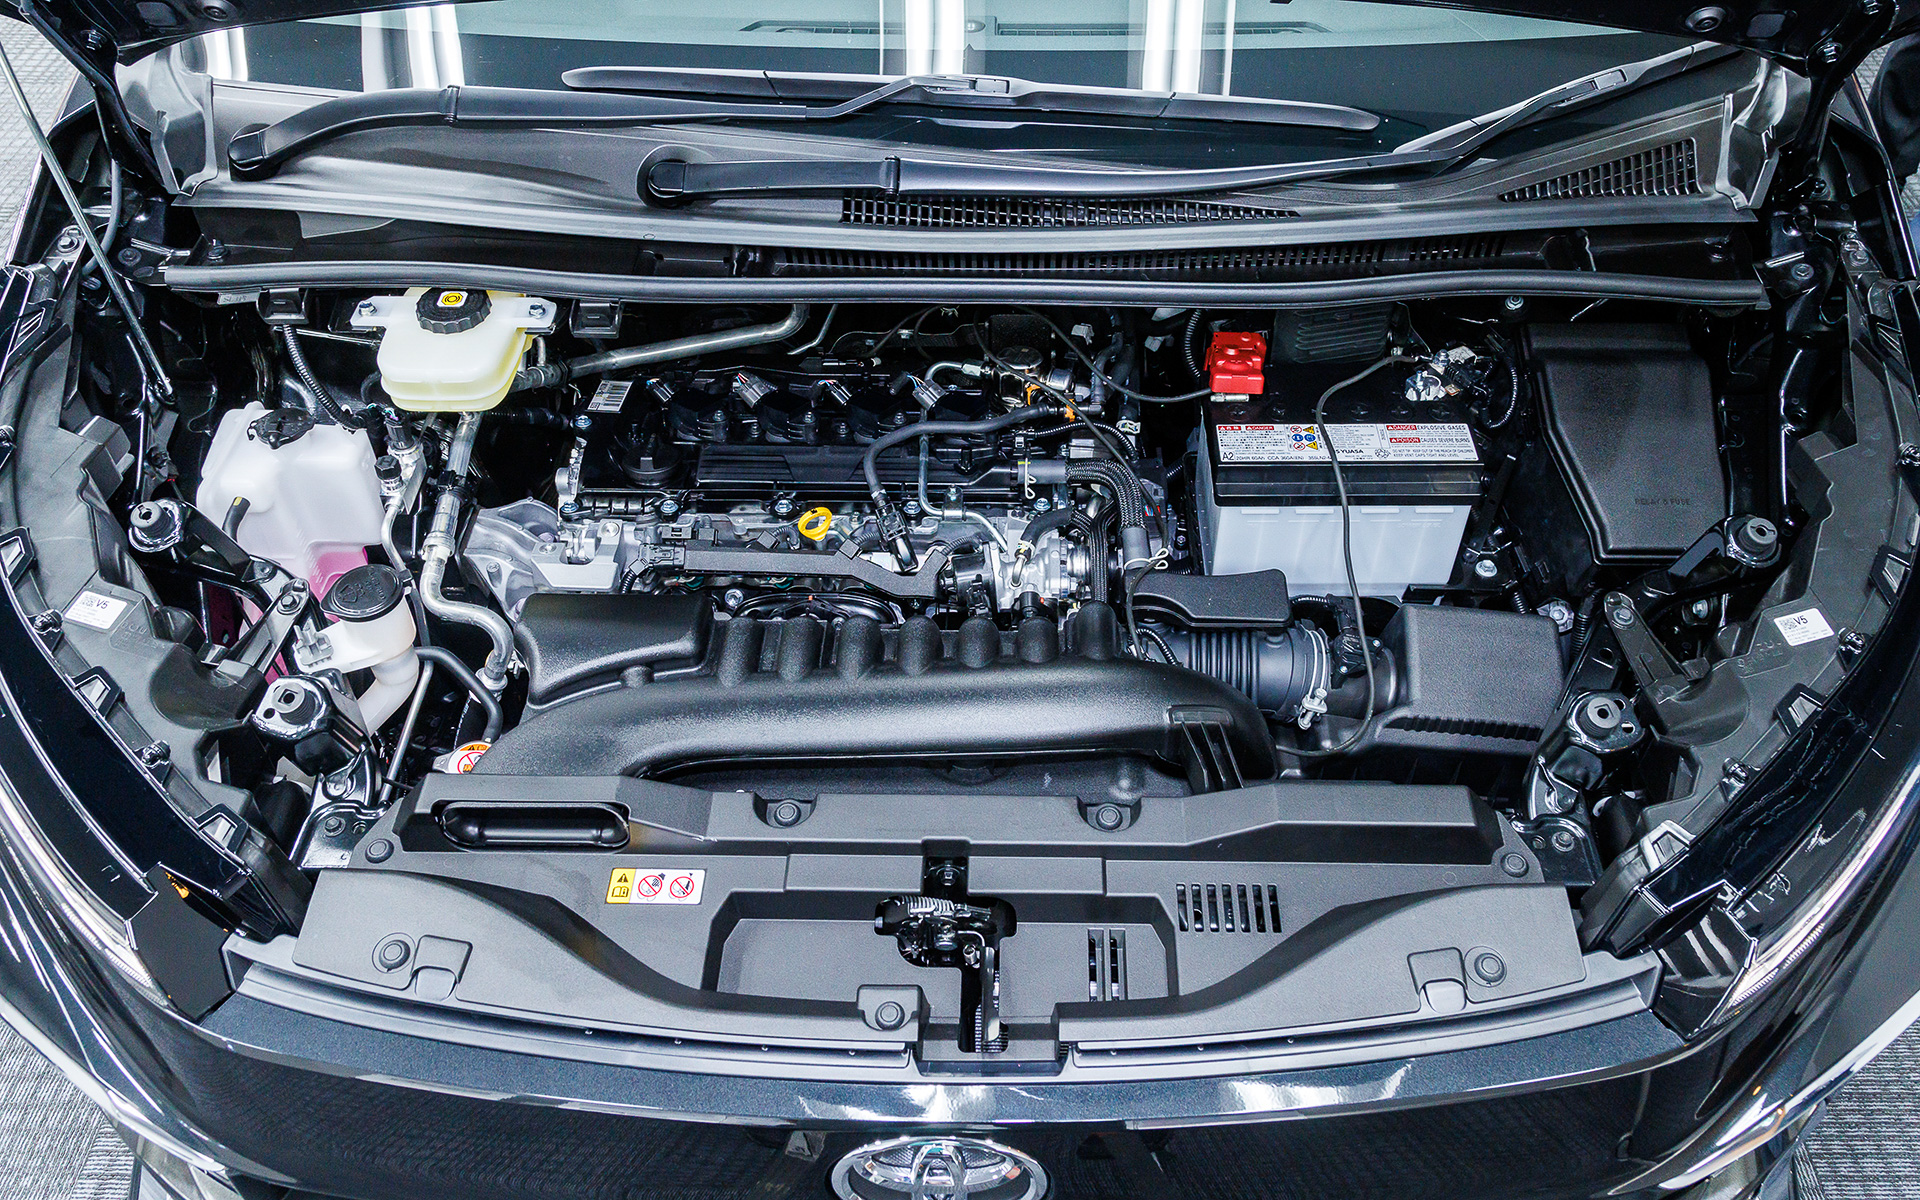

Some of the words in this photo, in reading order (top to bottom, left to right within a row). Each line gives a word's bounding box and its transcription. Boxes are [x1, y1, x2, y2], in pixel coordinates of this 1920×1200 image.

[1222, 452, 1234, 461] A2
[1635, 498, 1661, 506] RELAY
[1670, 498, 1691, 506] FUSE
[96, 599, 110, 609] V5
[1793, 615, 1808, 625] V5
